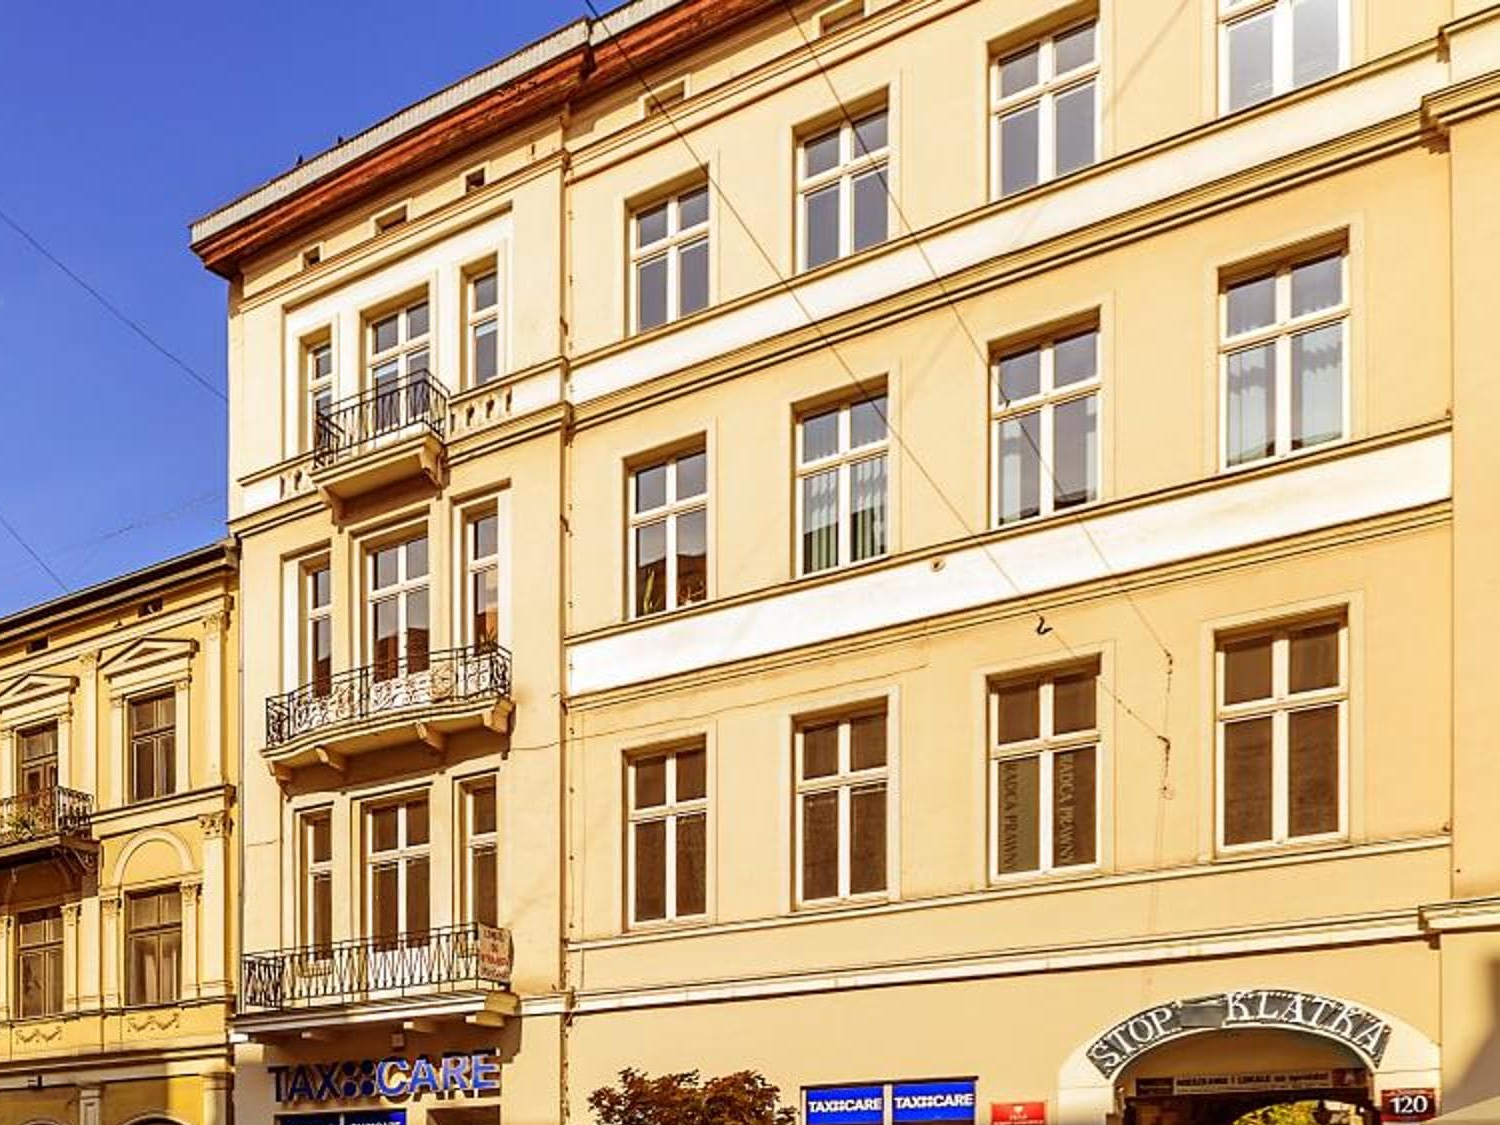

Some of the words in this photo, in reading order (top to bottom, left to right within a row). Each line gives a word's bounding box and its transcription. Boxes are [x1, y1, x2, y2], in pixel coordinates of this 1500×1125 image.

[1091, 1005, 1174, 1068] STOP
[1224, 990, 1391, 1055] KLATKA
[268, 1062, 342, 1102] TAX
[376, 1052, 500, 1097] CARE
[845, 1097, 882, 1111] CARE
[933, 1093, 973, 1107] CARE
[1389, 1095, 1428, 1114] 120
